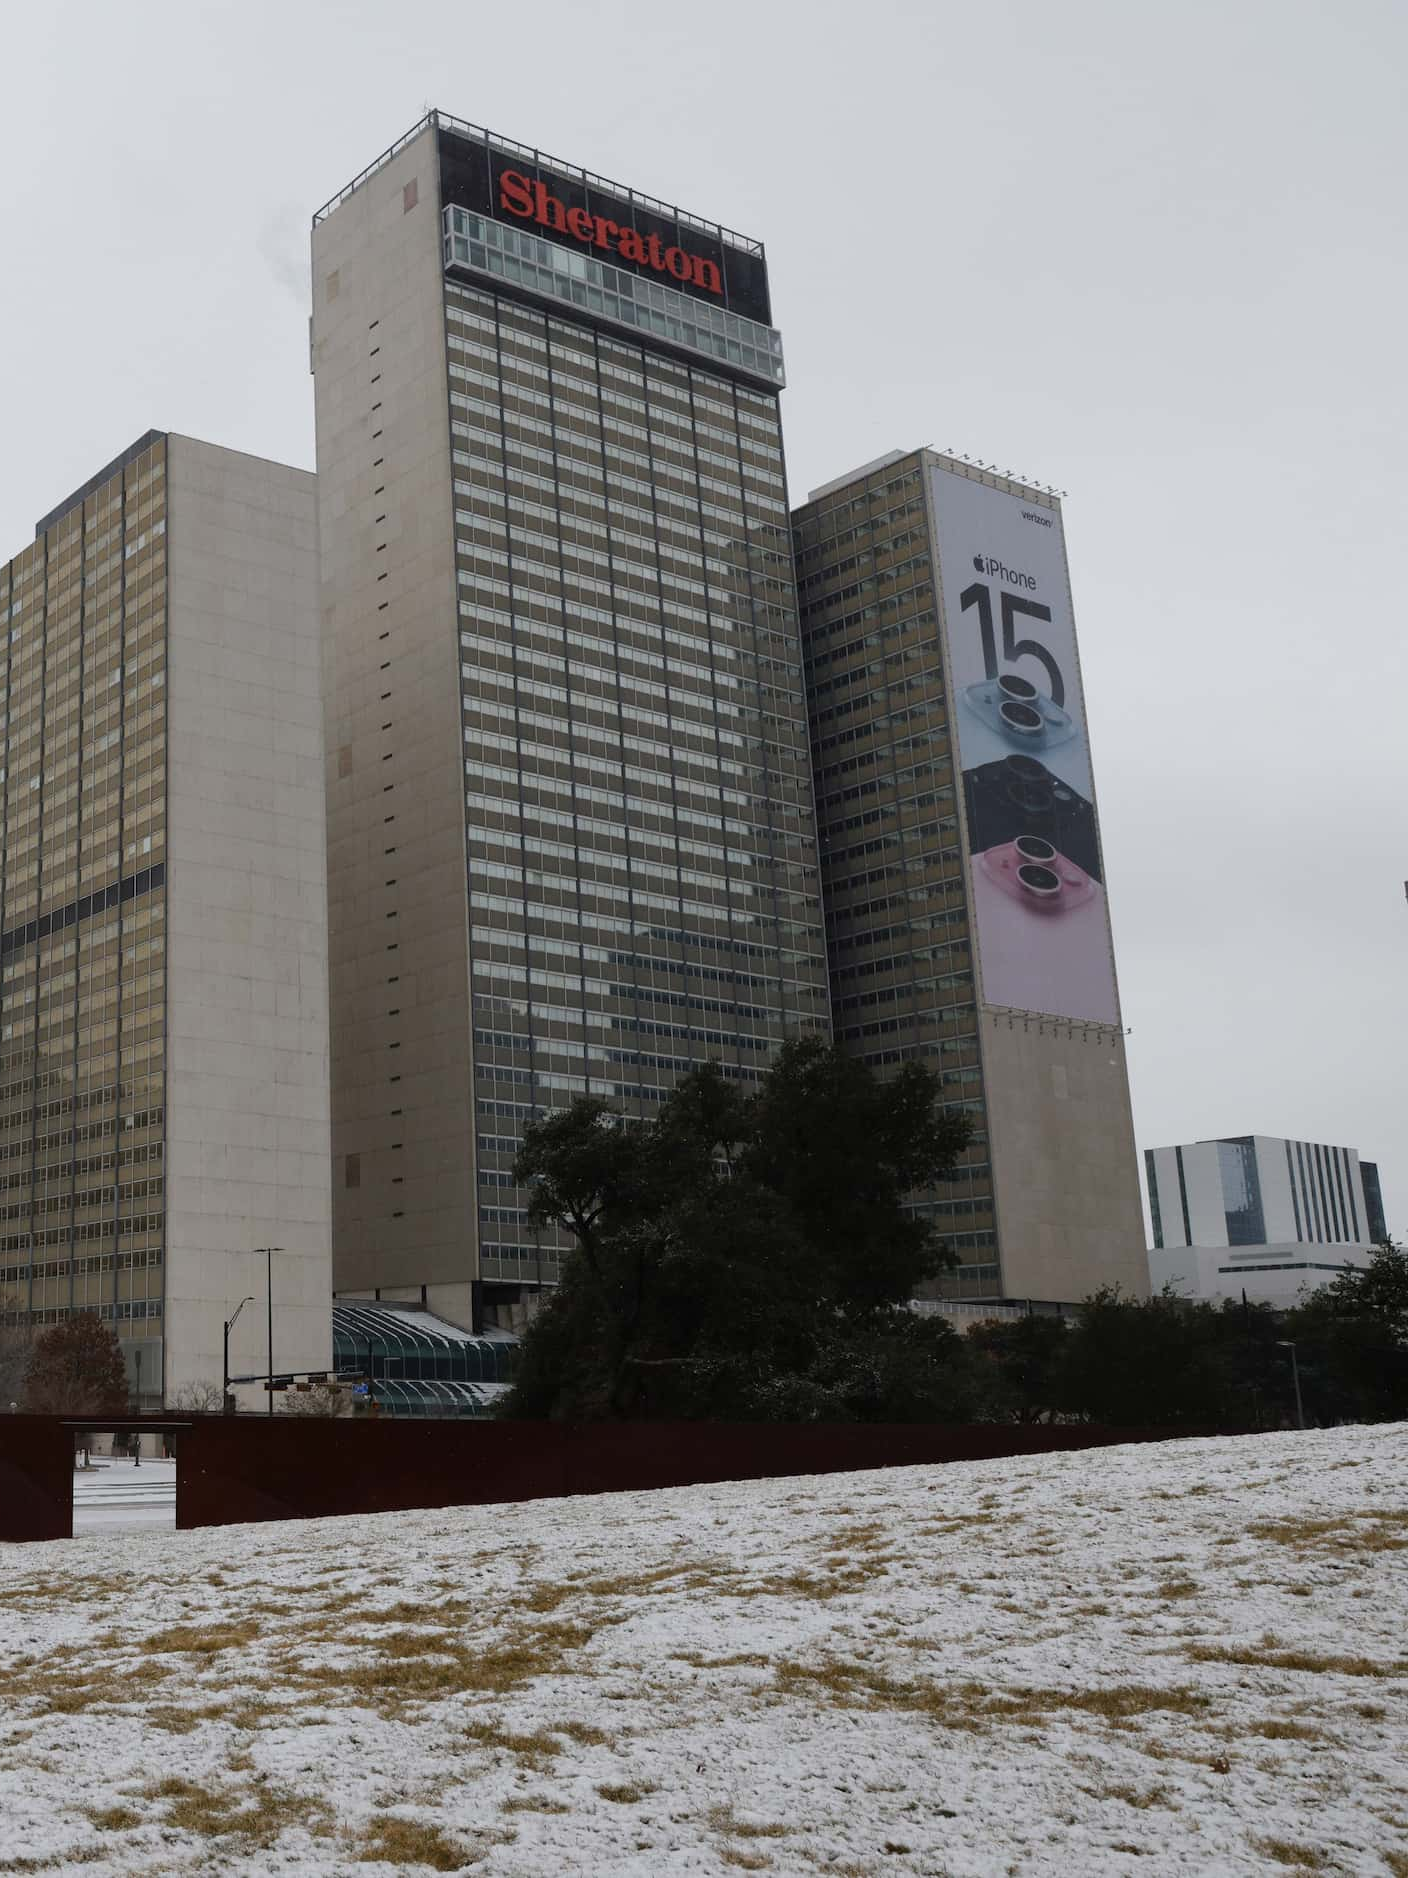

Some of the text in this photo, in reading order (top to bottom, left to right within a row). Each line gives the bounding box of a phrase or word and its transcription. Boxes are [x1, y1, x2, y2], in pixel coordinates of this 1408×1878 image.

[499, 170, 723, 294] Sheraton
[1021, 510, 1052, 528] verizon
[984, 558, 1037, 591] iPhone
[960, 582, 1065, 709] 15
